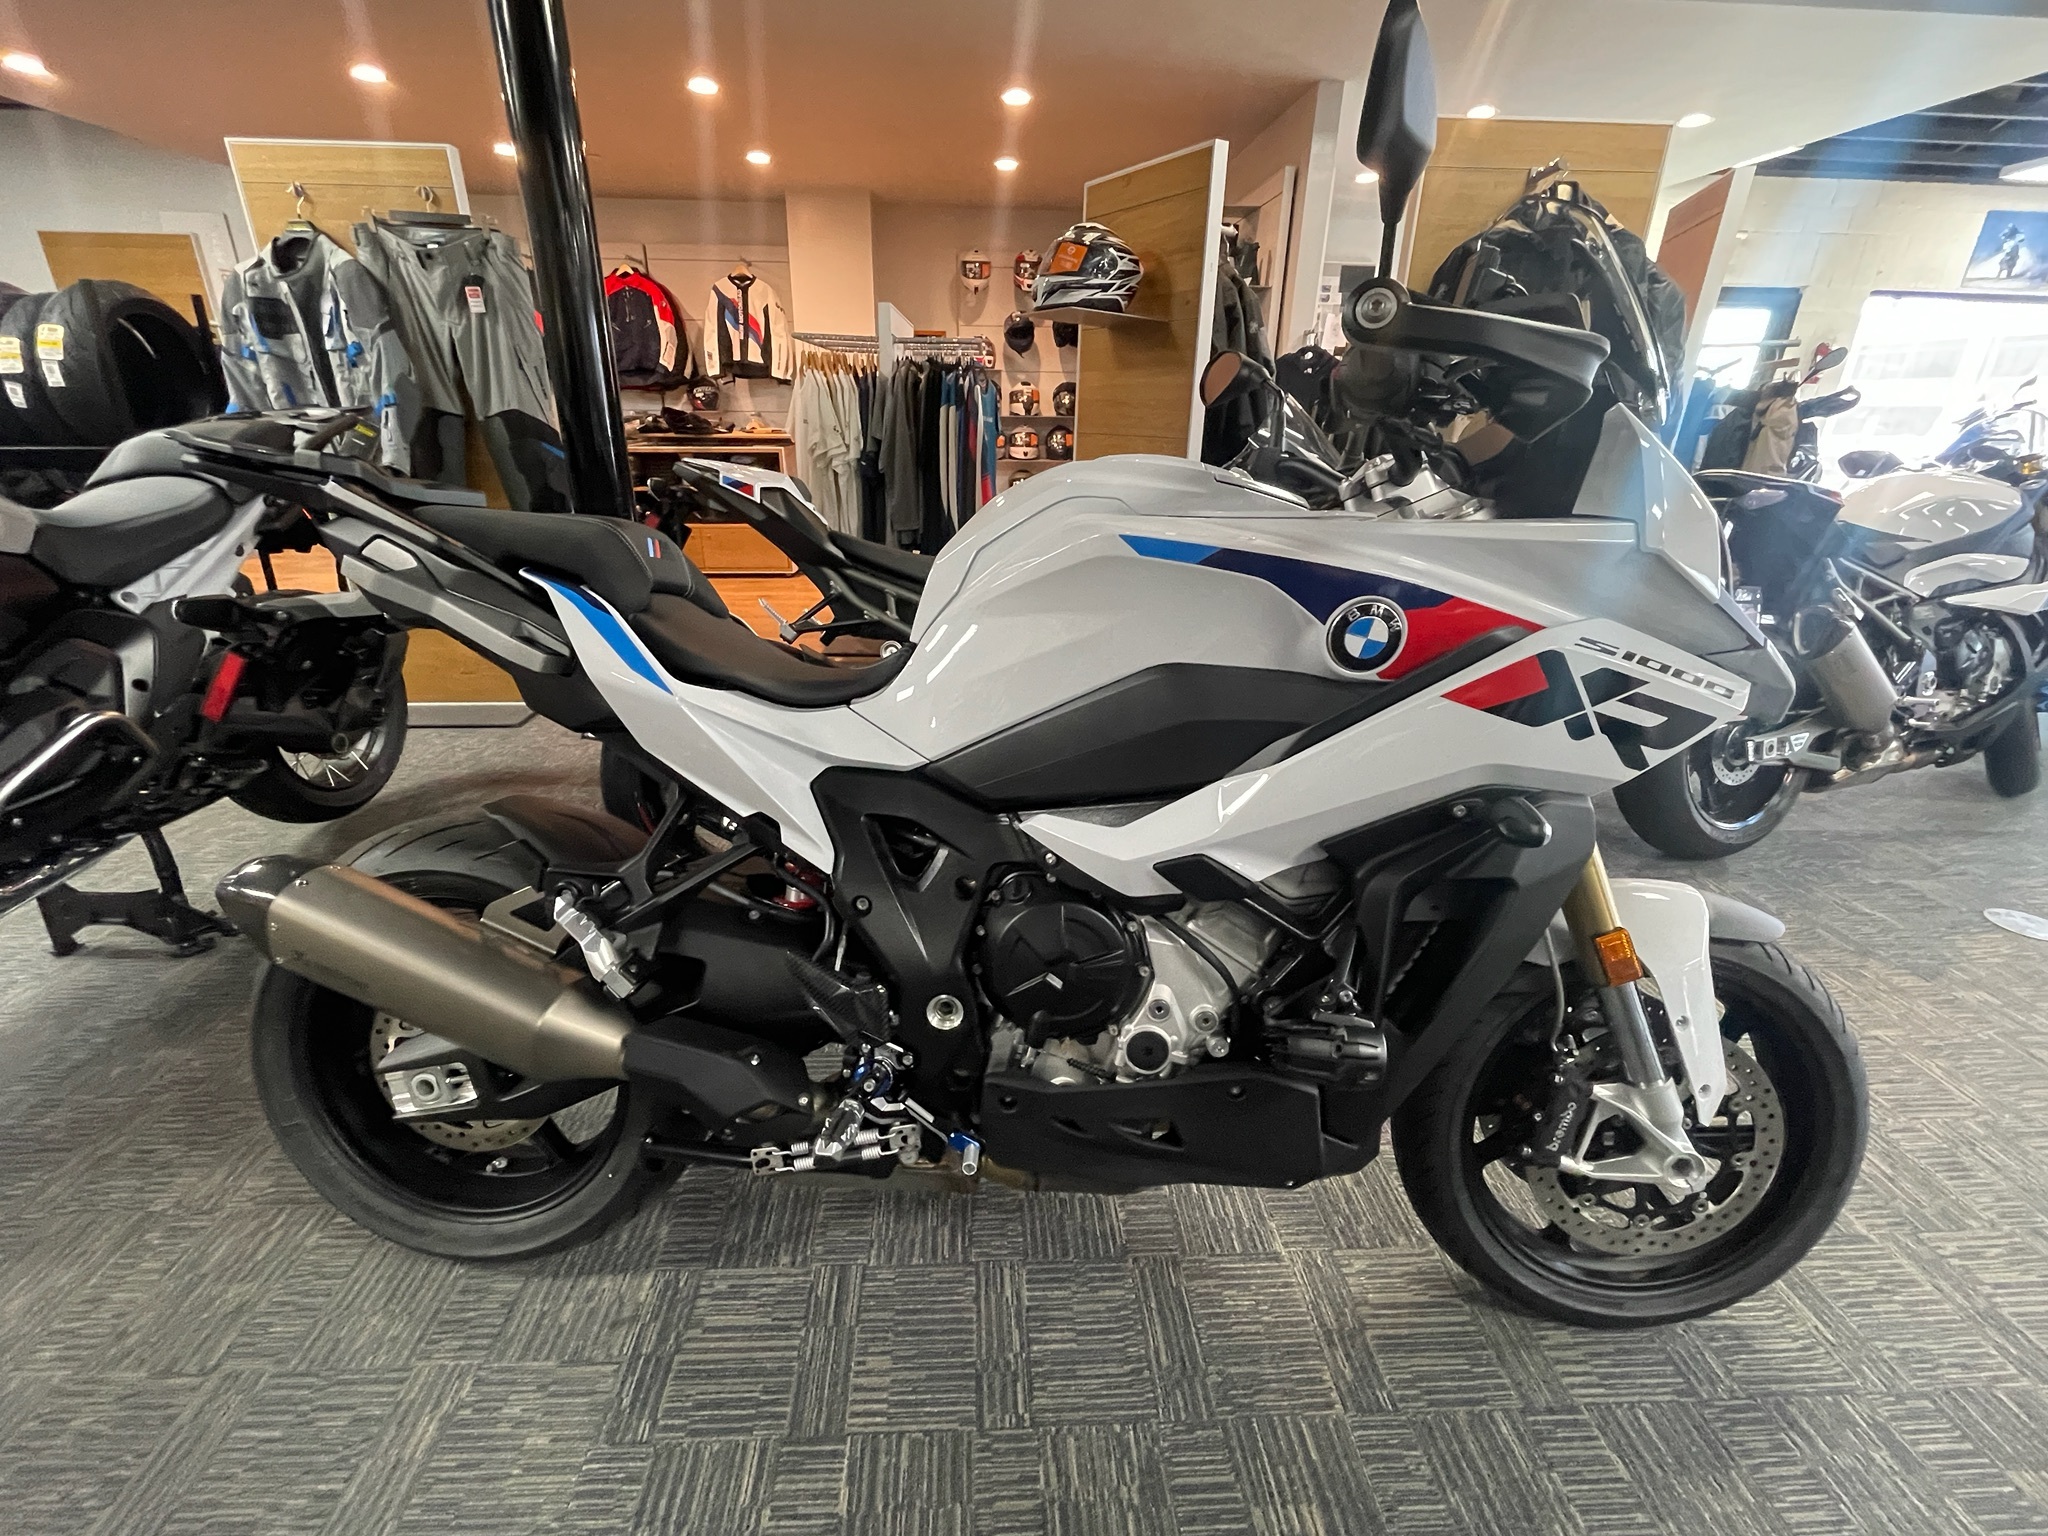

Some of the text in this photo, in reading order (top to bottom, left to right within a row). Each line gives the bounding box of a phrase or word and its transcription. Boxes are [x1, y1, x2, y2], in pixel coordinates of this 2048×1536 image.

[1346, 604, 1402, 632] BMW
[1574, 636, 1735, 700] S1000
[1545, 1102, 1577, 1152] brembo
